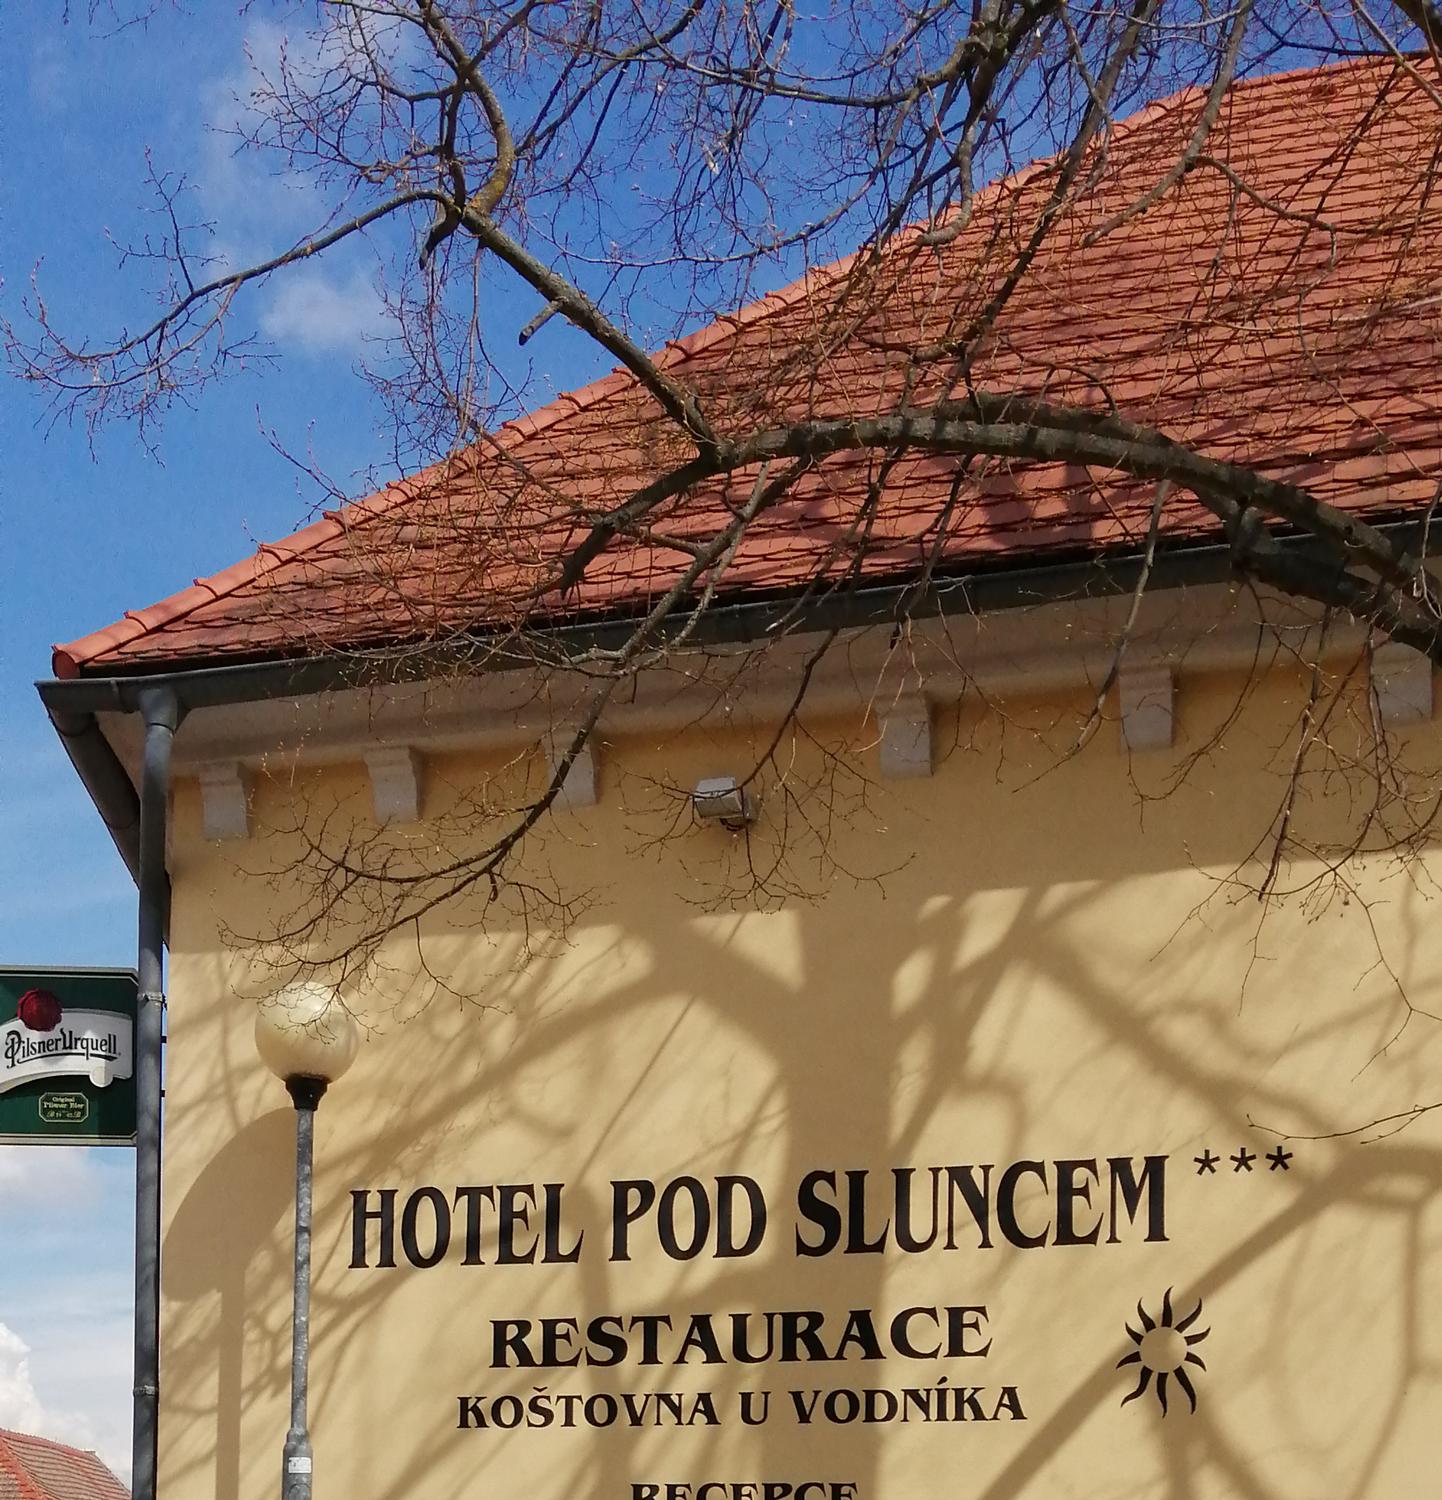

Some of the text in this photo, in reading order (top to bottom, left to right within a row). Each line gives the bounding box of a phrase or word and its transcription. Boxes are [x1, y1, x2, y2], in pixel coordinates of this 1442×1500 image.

[4, 1028, 117, 1069] Pilsner Urquell
[347, 1155, 1171, 1270] HOTEL POD SLUNCEM
[488, 1305, 994, 1369] RESTAURACE
[455, 1378, 1029, 1430] KOŠTOVNA U VODNÍKA
